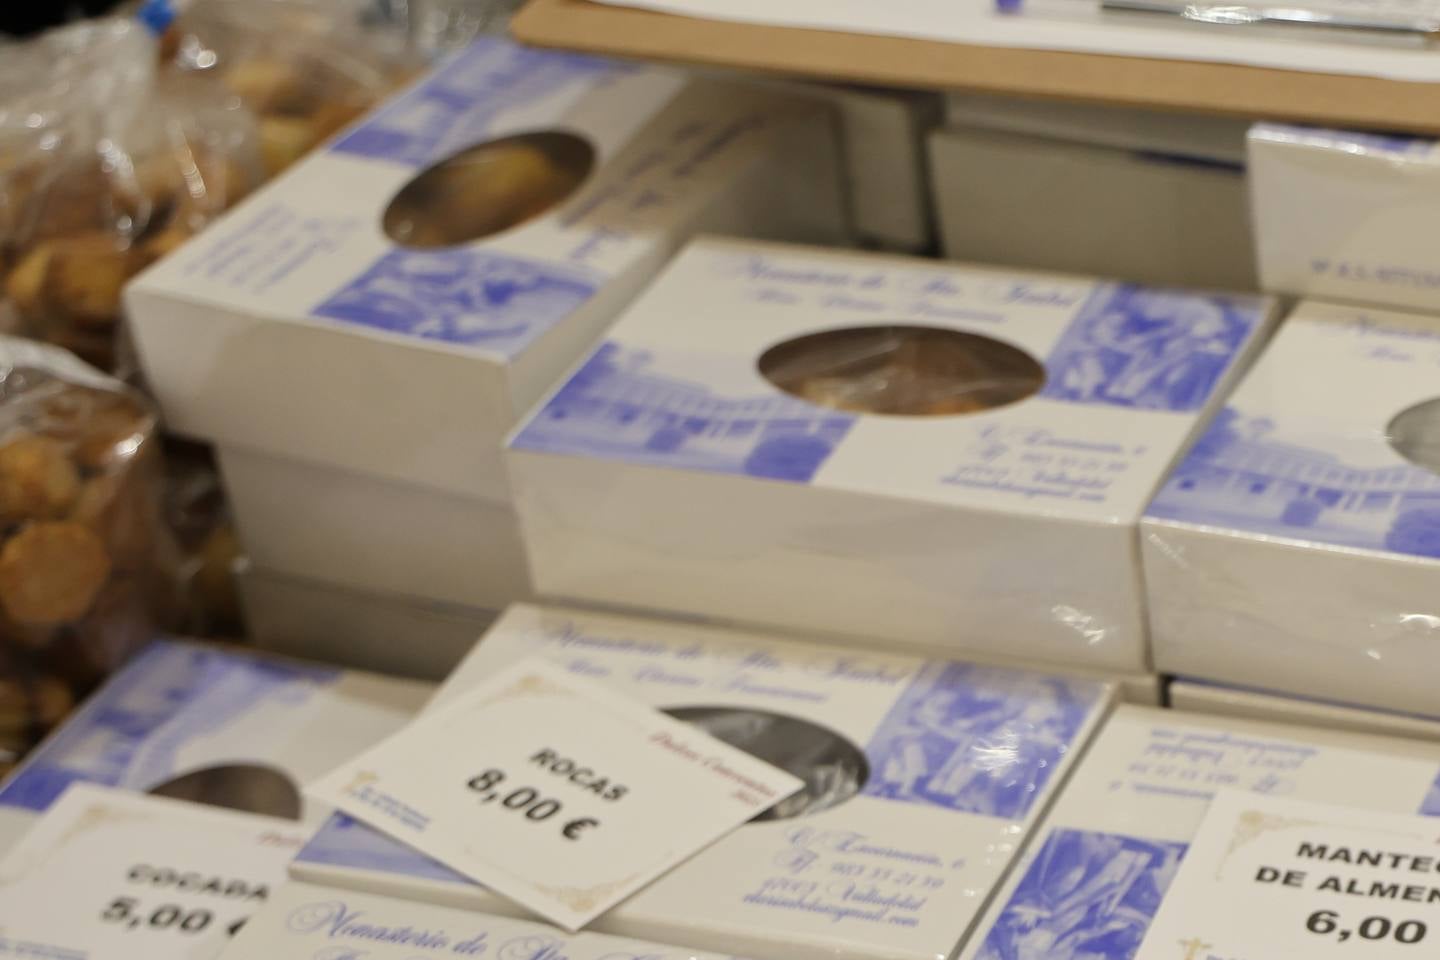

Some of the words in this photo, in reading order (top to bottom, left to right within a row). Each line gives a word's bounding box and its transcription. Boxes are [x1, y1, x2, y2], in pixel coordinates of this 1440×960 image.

[529, 747, 631, 803] ROCAS
[466, 768, 565, 822] 8,00
[561, 817, 602, 841] €
[1254, 866, 1308, 888] DE
[102, 896, 213, 932] 5,00
[286, 901, 446, 951] Monasterio
[452, 932, 490, 956] de
[1305, 909, 1428, 947] 6,00
